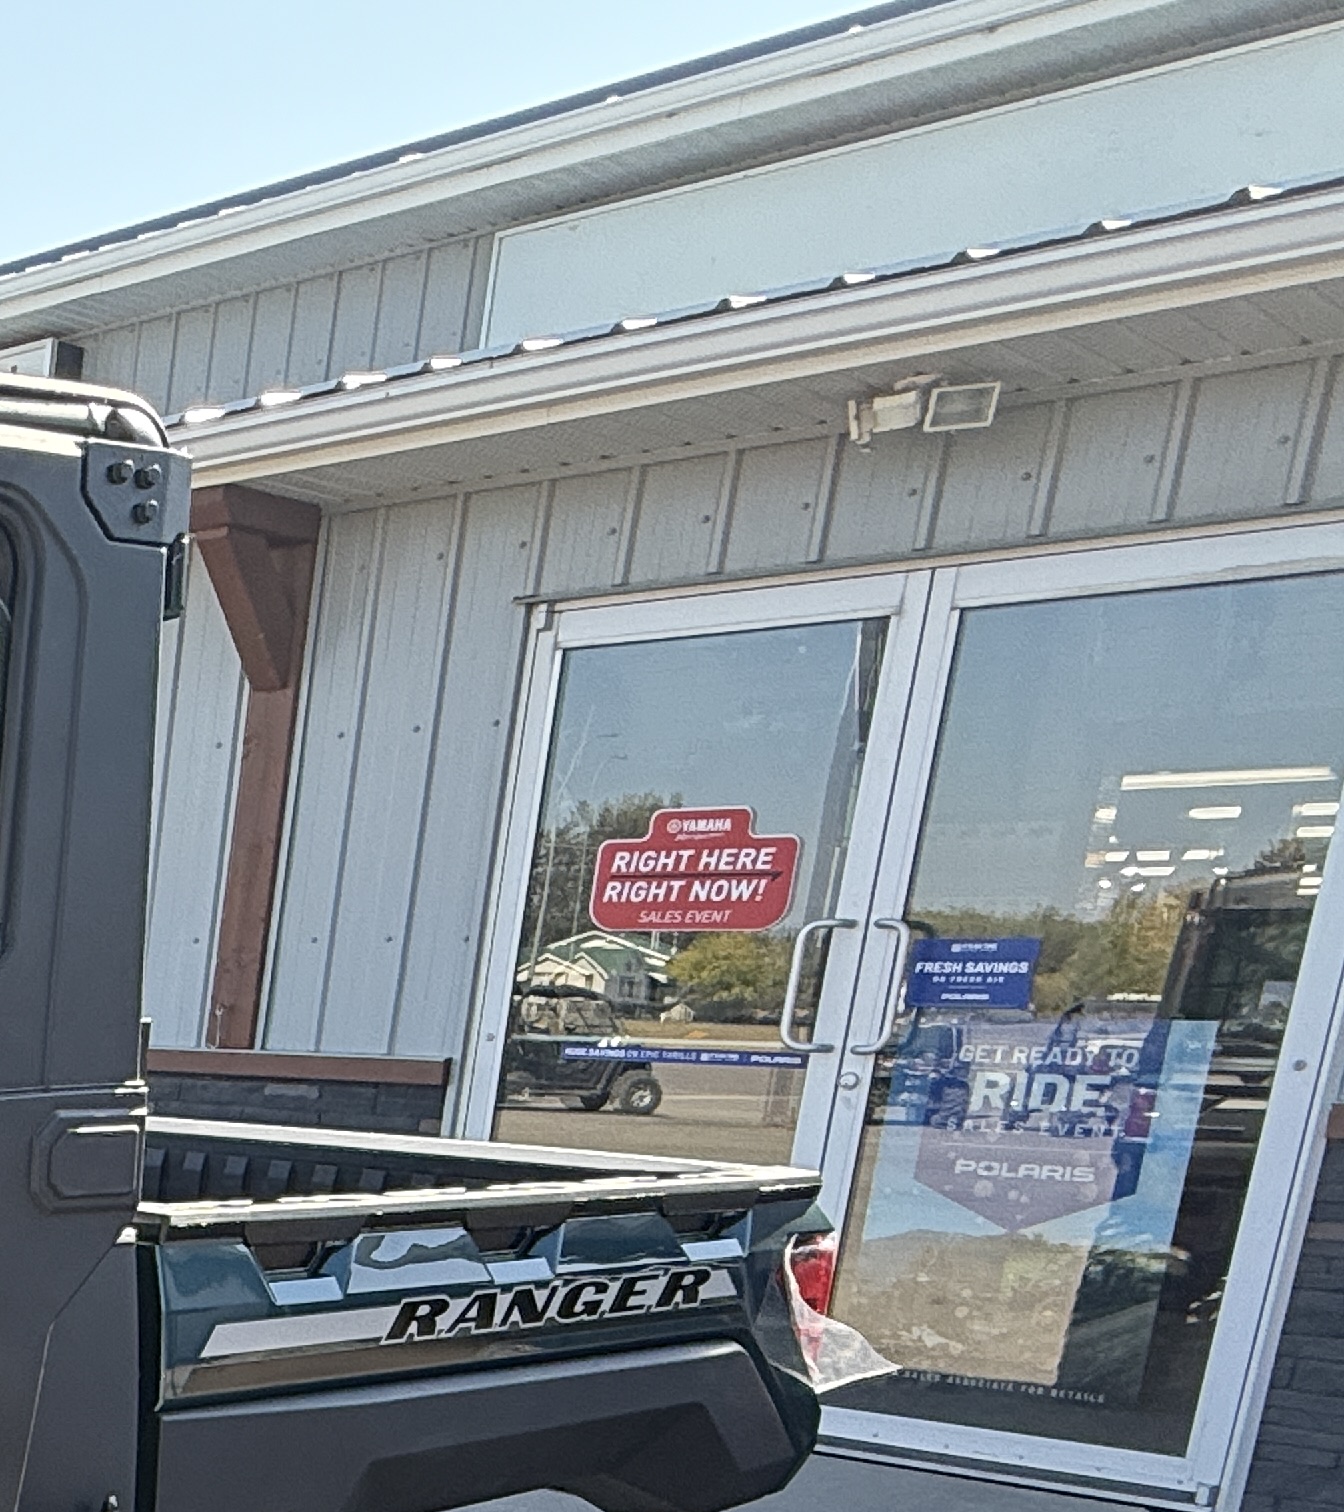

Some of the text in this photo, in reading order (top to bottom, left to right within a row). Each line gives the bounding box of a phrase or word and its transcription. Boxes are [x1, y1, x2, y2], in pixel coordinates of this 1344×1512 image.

[681, 818, 732, 833] YAMAHA
[611, 846, 777, 873] RIGHT HERE
[603, 878, 768, 903] RIGHT NOW!
[637, 909, 733, 924] SALES EVENT
[915, 961, 1030, 974] FRESH SAVINGS
[958, 1044, 1140, 1069] GET READY TO
[967, 1070, 1112, 1115] RIDE
[947, 1118, 1126, 1139] SALES EVENT
[954, 1159, 1096, 1183] POLARIS
[381, 1265, 712, 1344] RANGER
